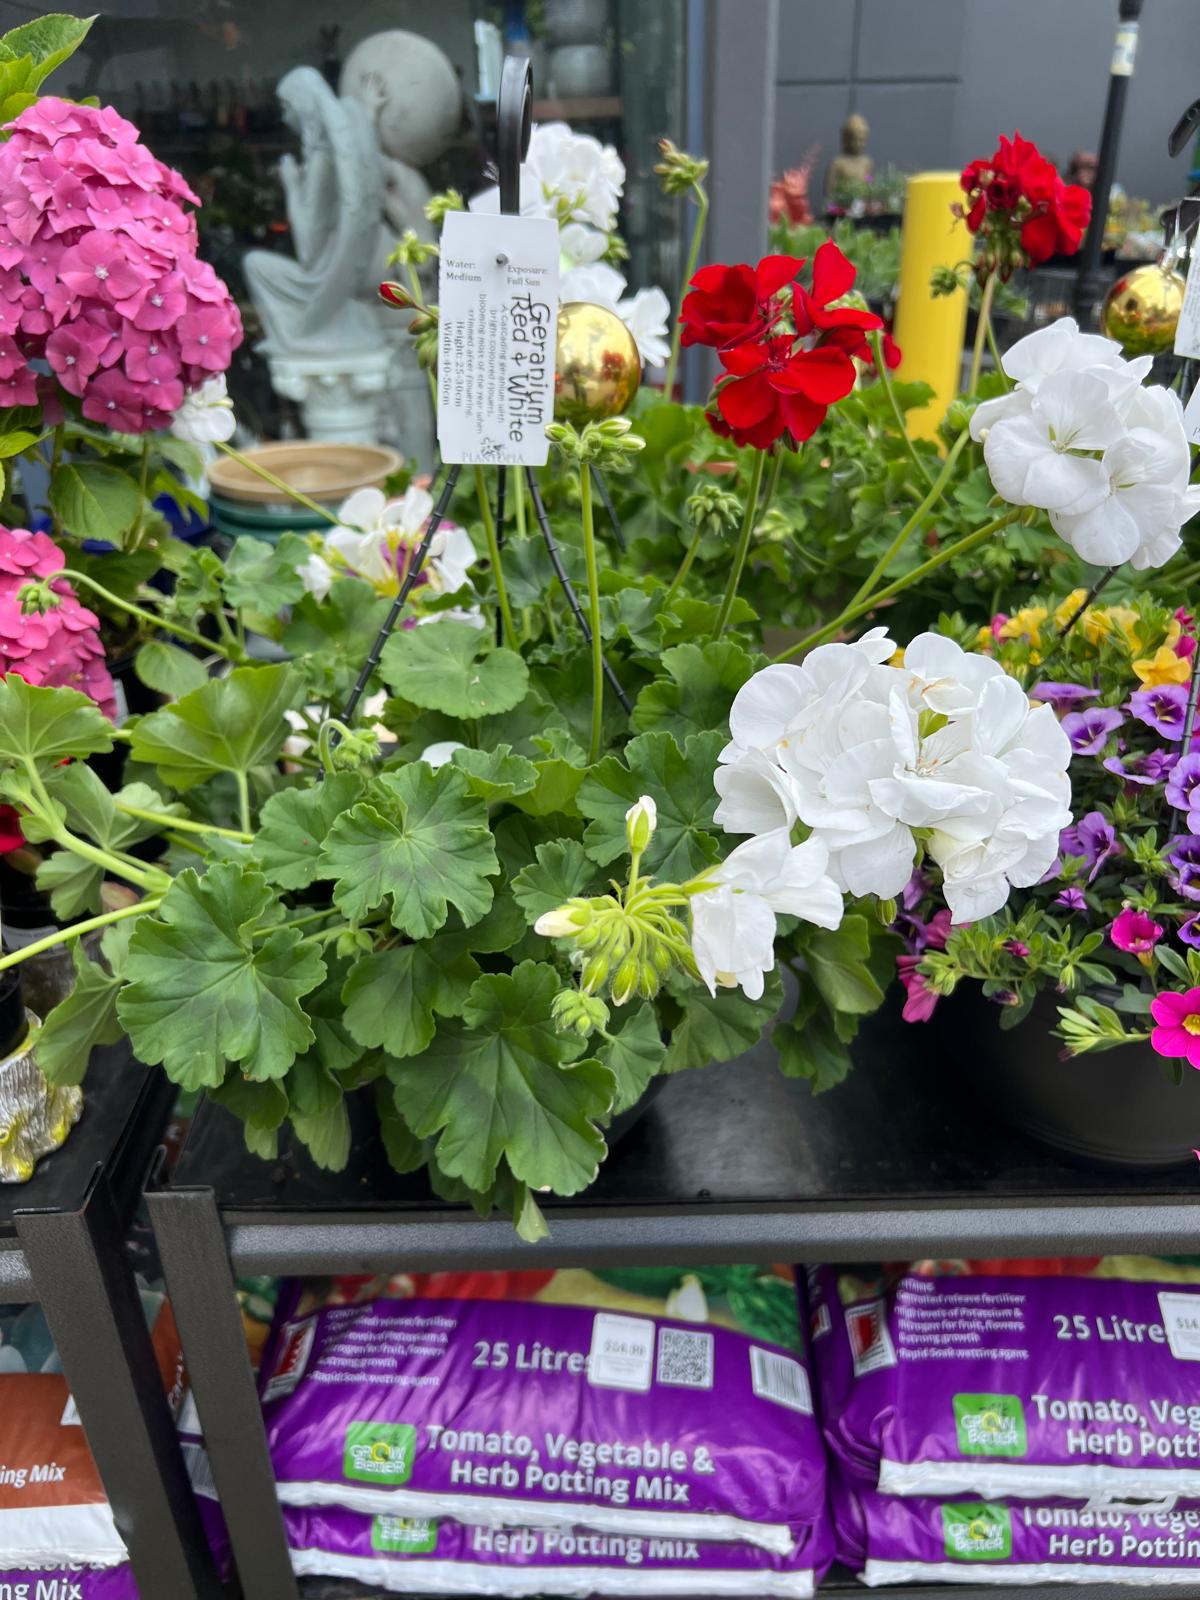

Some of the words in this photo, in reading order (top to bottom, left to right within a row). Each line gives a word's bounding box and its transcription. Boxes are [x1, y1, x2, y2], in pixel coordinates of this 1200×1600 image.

[445, 260, 476, 269] Water:
[445, 272, 482, 282] Medium
[525, 278, 541, 286] Sun
[510, 292, 531, 343] Red
[511, 352, 528, 367] &
[527, 302, 551, 425] Geranium
[507, 373, 530, 442] White
[1053, 1315, 1090, 1340] 25
[1096, 1315, 1166, 1343] Litre
[472, 1341, 509, 1369] 25
[1031, 1395, 1147, 1428] Tomato,
[1151, 1399, 1200, 1432] Veg
[426, 1424, 540, 1463] Tomato,
[545, 1432, 687, 1470] Vegetable
[692, 1446, 715, 1474] &
[1067, 1428, 1133, 1456] Herb
[29, 1462, 66, 1482] Mix
[451, 1459, 519, 1488] Herb
[525, 1465, 630, 1504] Potting
[635, 1475, 690, 1502] Mix
[473, 1527, 538, 1555] Herb
[542, 1531, 644, 1564] Potting
[1049, 1534, 1114, 1557] Herb
[35, 1577, 82, 1600] Mix
